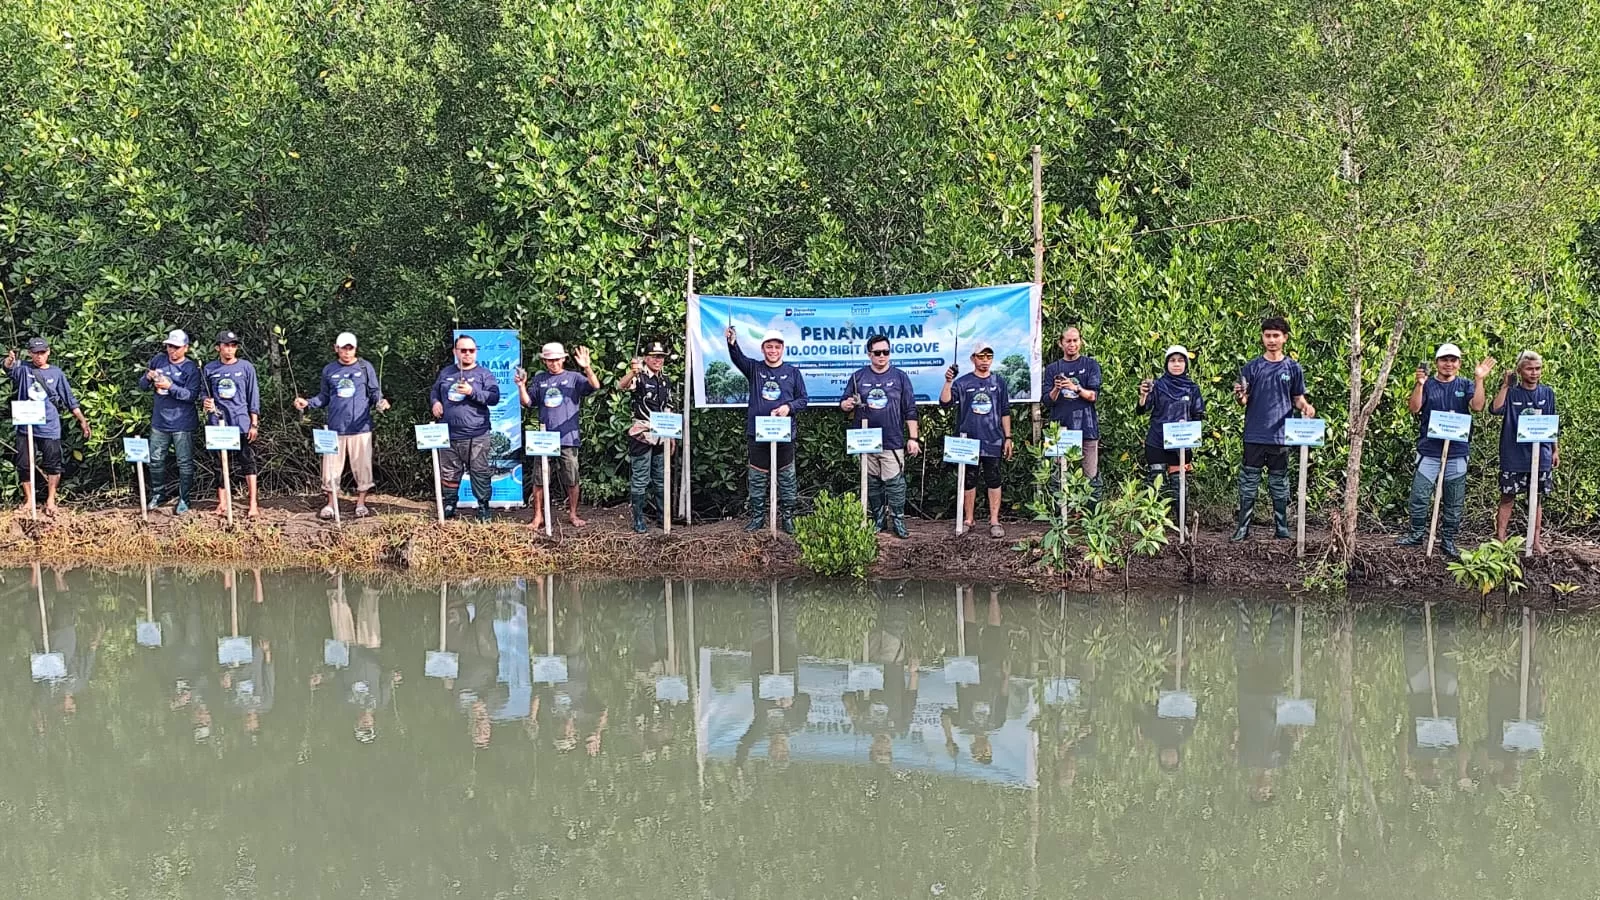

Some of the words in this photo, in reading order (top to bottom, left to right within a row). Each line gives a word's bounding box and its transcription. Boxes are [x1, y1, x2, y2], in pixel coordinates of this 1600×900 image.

[801, 324, 923, 340] PENANAMAN
[786, 345, 826, 356] 10.000
[830, 344, 862, 355] BIBIT
[864, 342, 940, 354] NGROVE
